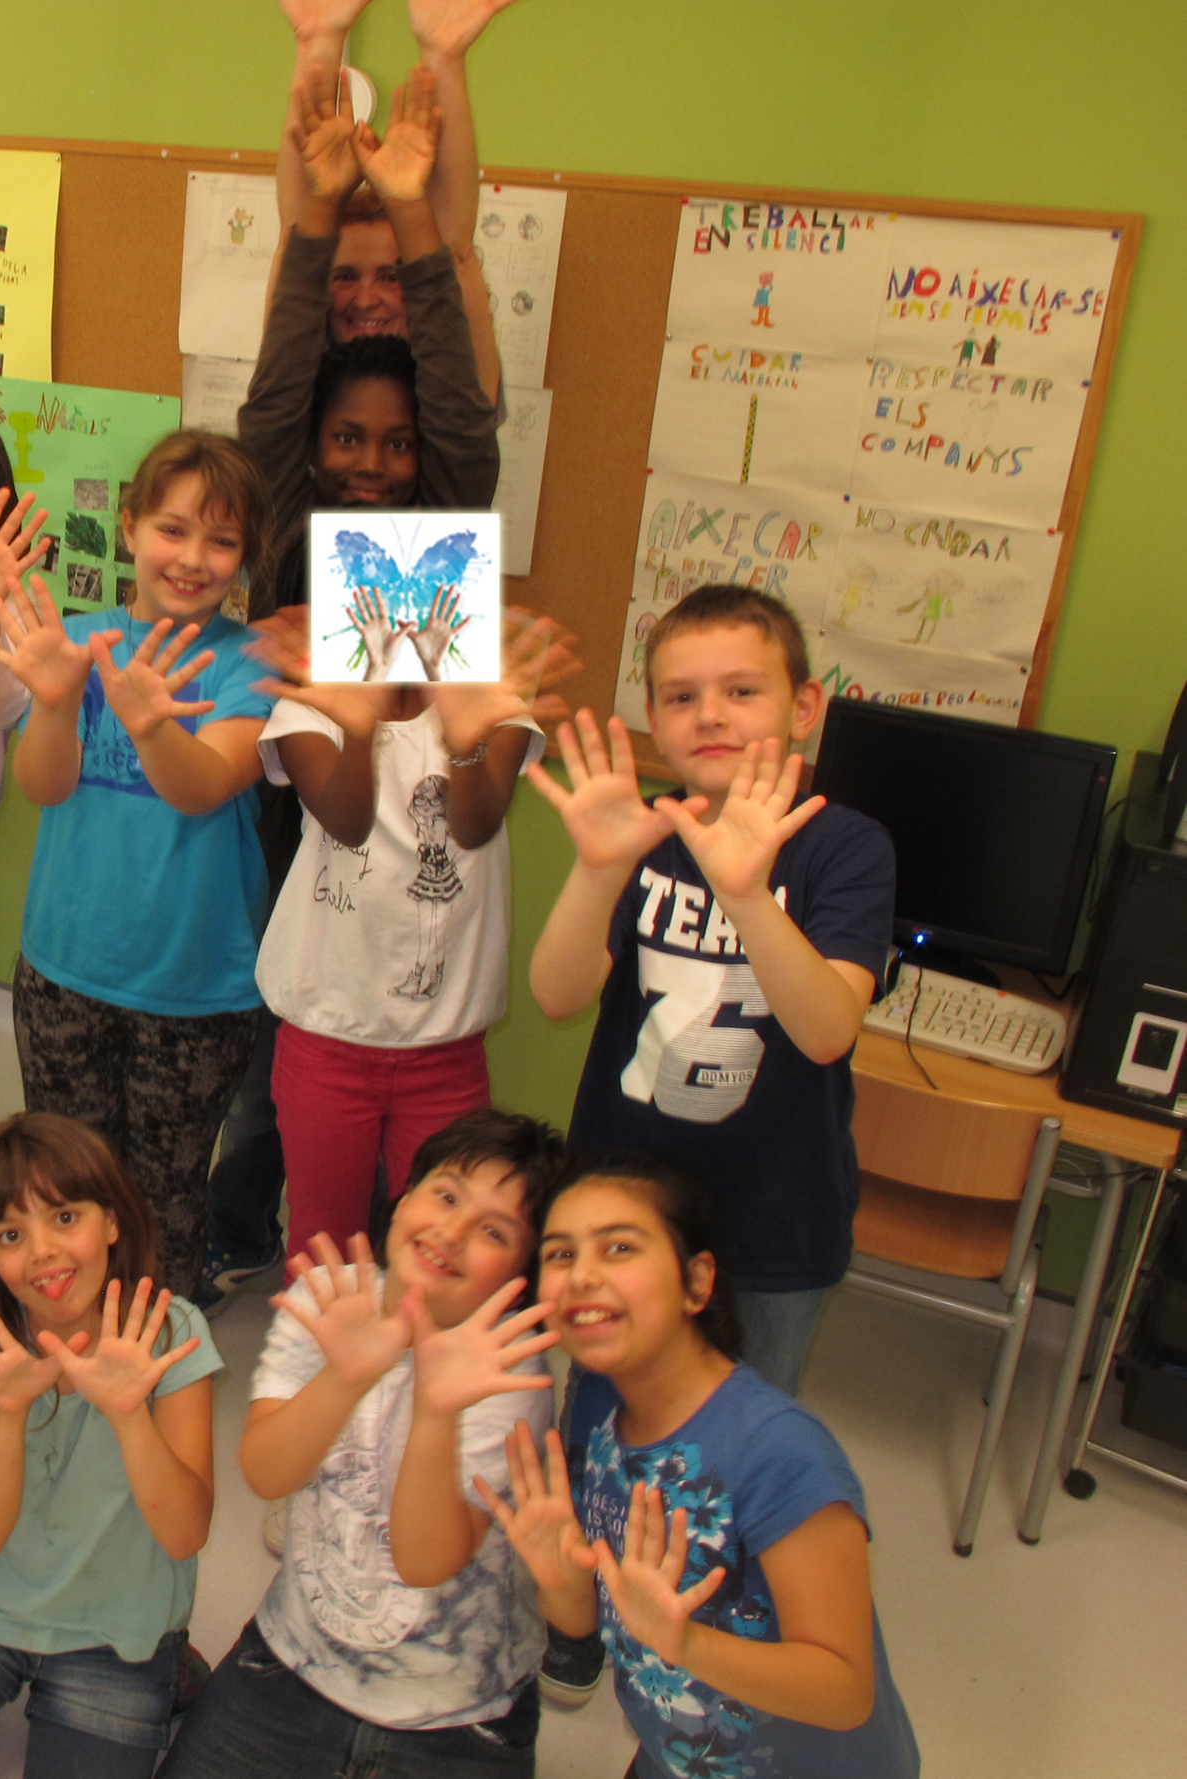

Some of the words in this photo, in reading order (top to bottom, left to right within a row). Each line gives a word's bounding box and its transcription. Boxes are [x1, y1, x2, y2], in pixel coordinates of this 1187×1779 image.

[689, 201, 875, 231] TREBALLAR
[694, 223, 731, 253] EN
[747, 226, 845, 254] SILENCI
[887, 267, 941, 301] NO
[691, 344, 803, 373] CUIDAR
[870, 358, 1054, 403] RESPECTAR
[875, 397, 930, 429] ELS
[861, 433, 1034, 477] COMPANYS
[856, 506, 896, 532] NO
[700, 1069, 754, 1085] DOMYOS
